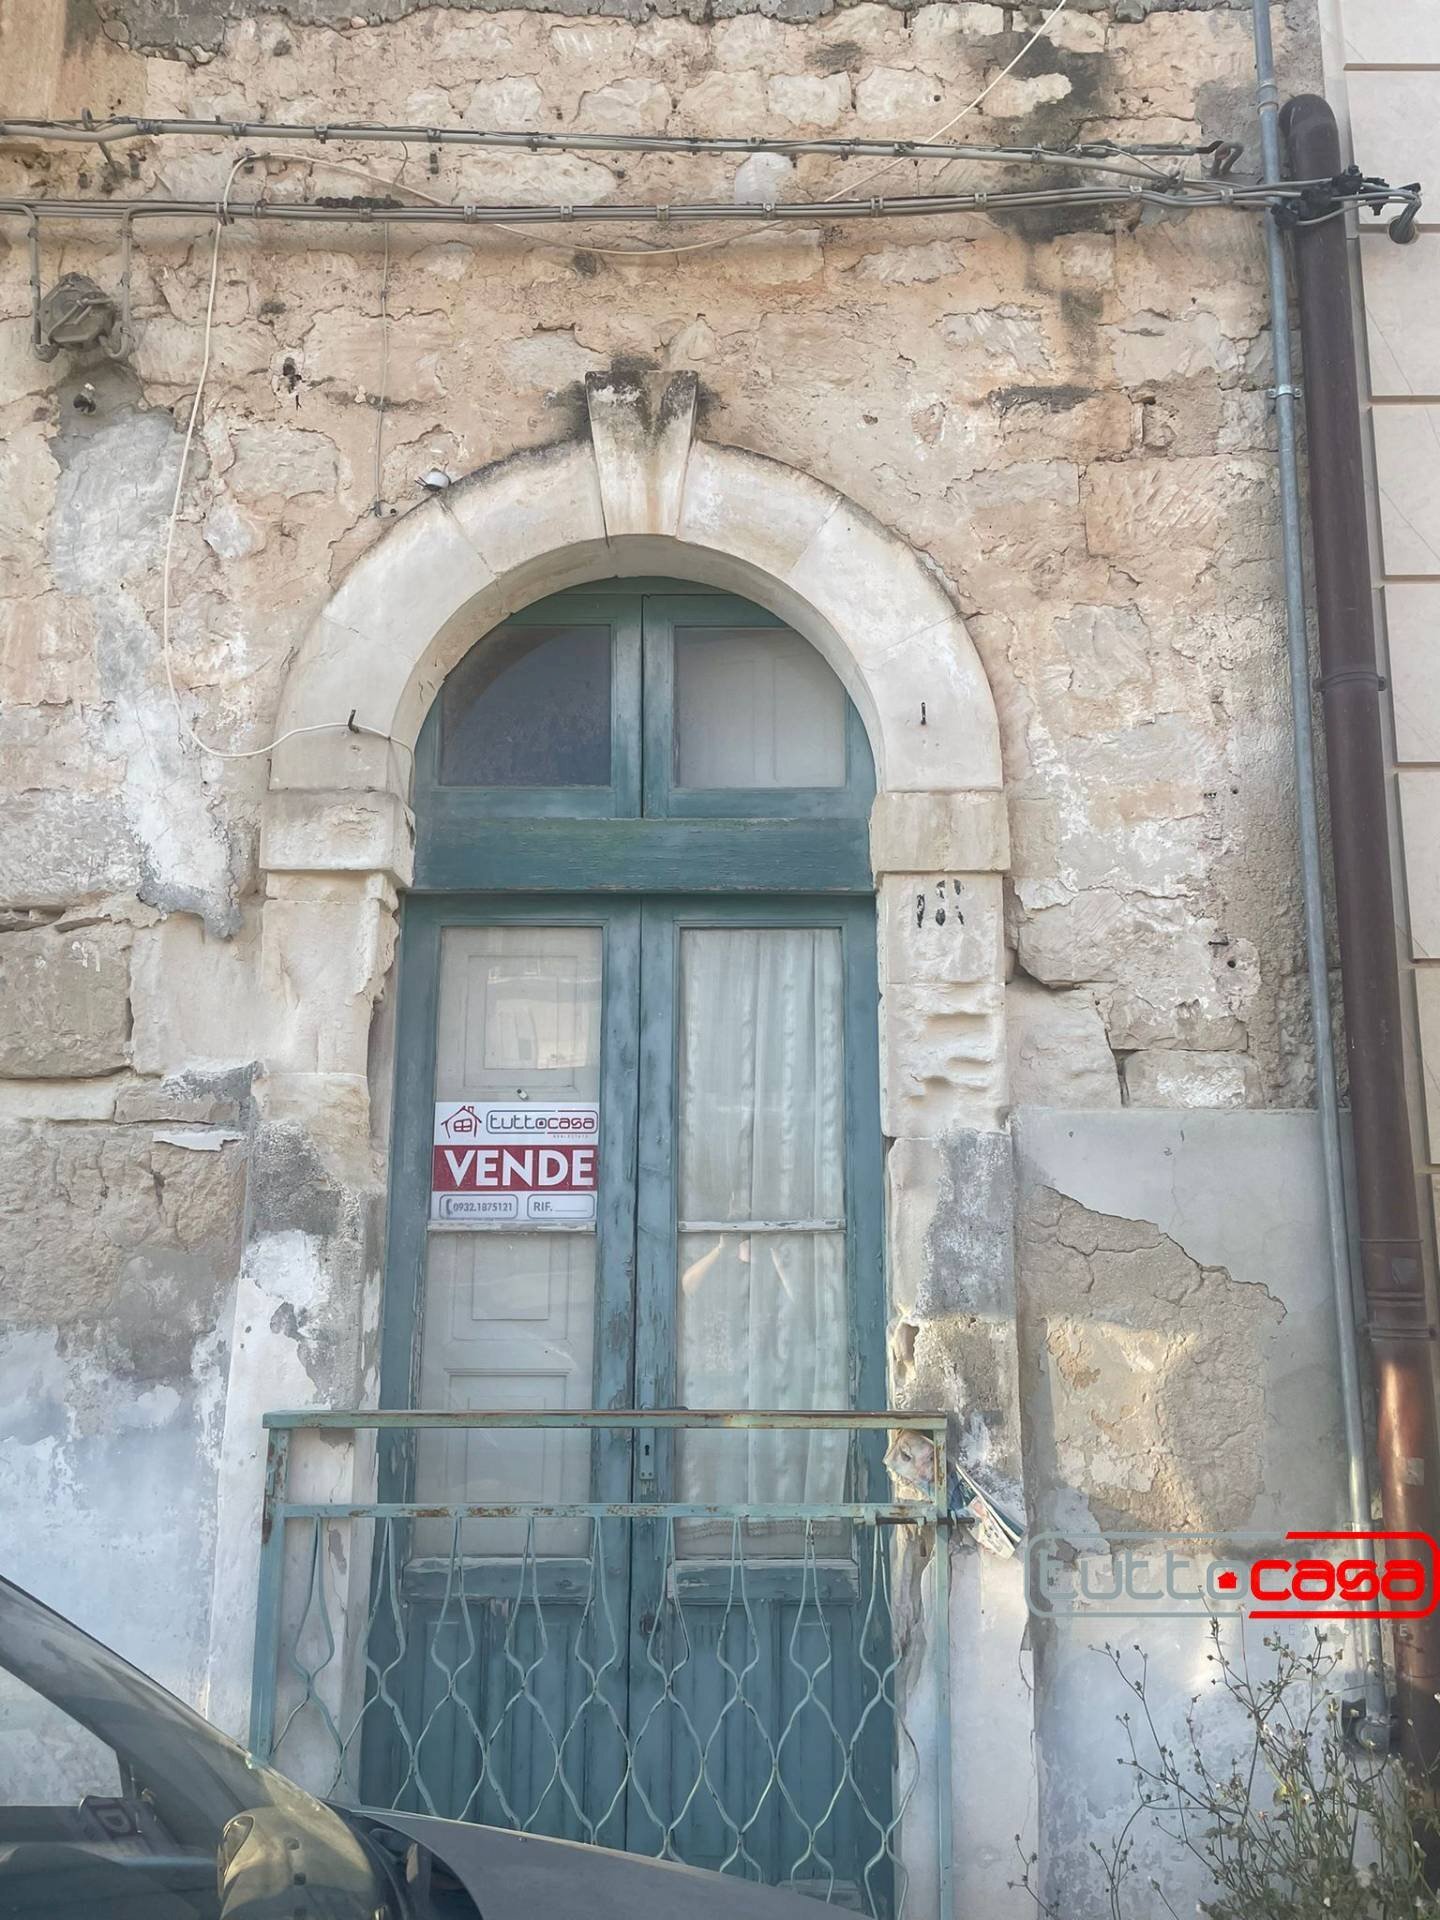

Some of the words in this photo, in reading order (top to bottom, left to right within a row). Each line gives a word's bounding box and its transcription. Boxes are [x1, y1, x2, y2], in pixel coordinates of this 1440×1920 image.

[490, 1114, 595, 1130] tuttocasa
[444, 1149, 594, 1187] VENDE
[453, 1201, 513, 1212] 0932.1875121
[534, 1201, 553, 1212] RIF.
